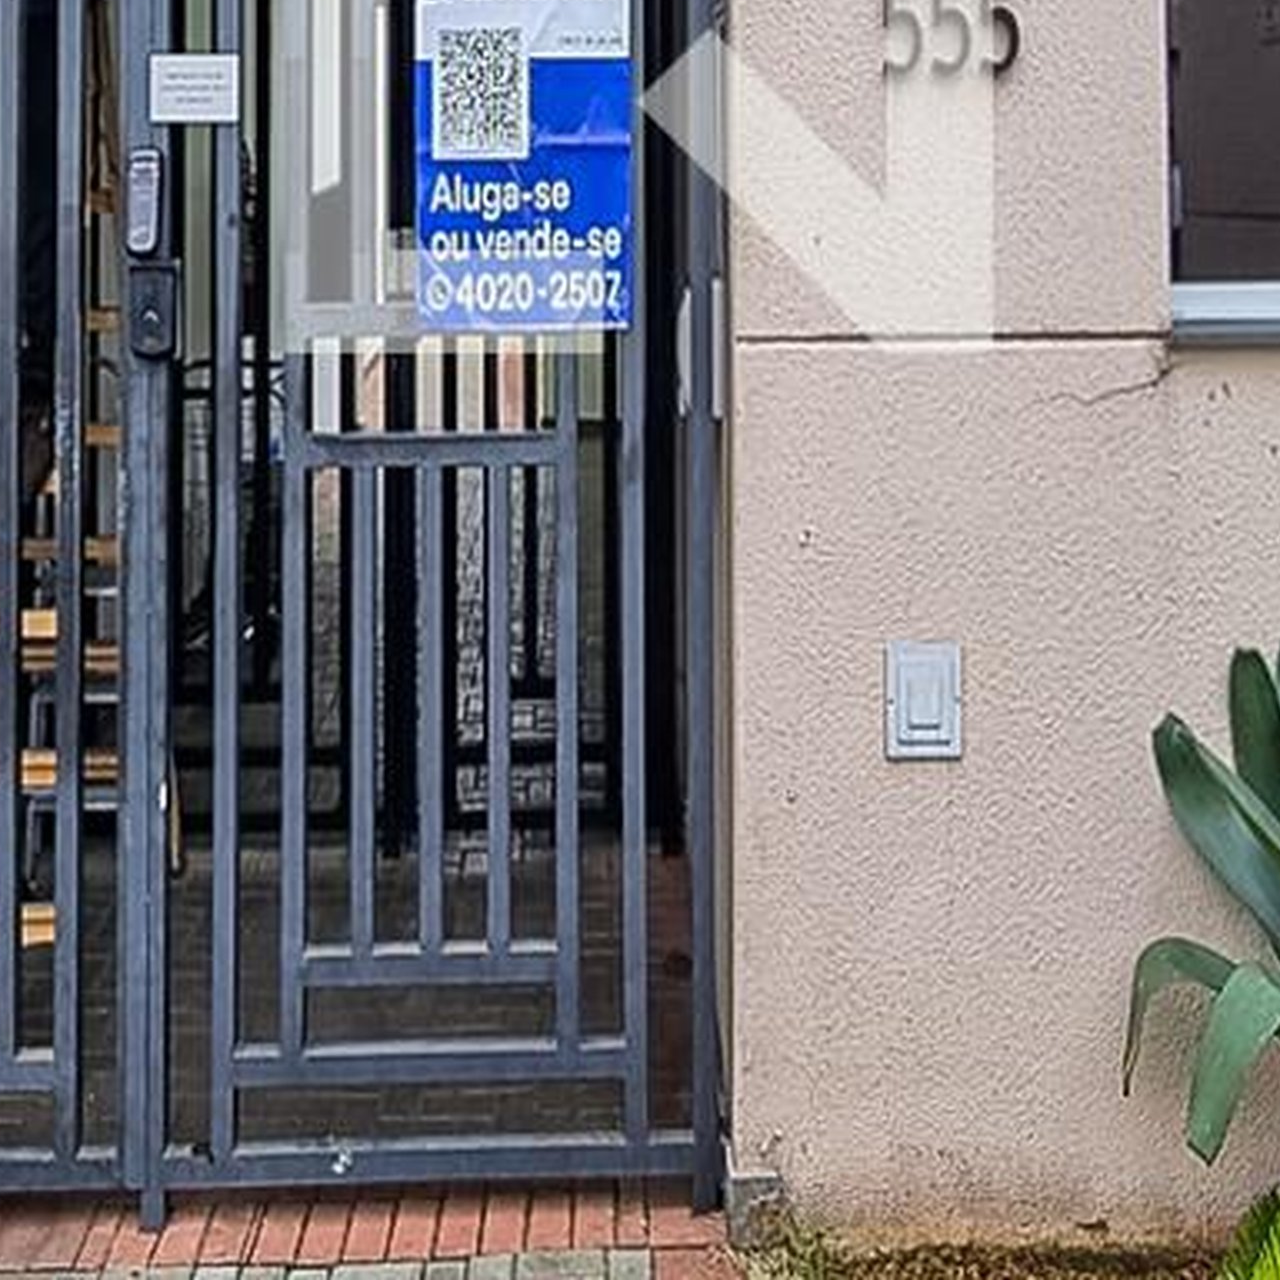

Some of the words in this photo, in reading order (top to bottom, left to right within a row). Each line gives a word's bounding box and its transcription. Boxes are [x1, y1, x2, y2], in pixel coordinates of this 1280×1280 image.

[430, 173, 571, 220] Aluga-se
[431, 229, 471, 262] ou
[475, 220, 622, 261] vende-se
[455, 270, 622, 312] 4020-2507
